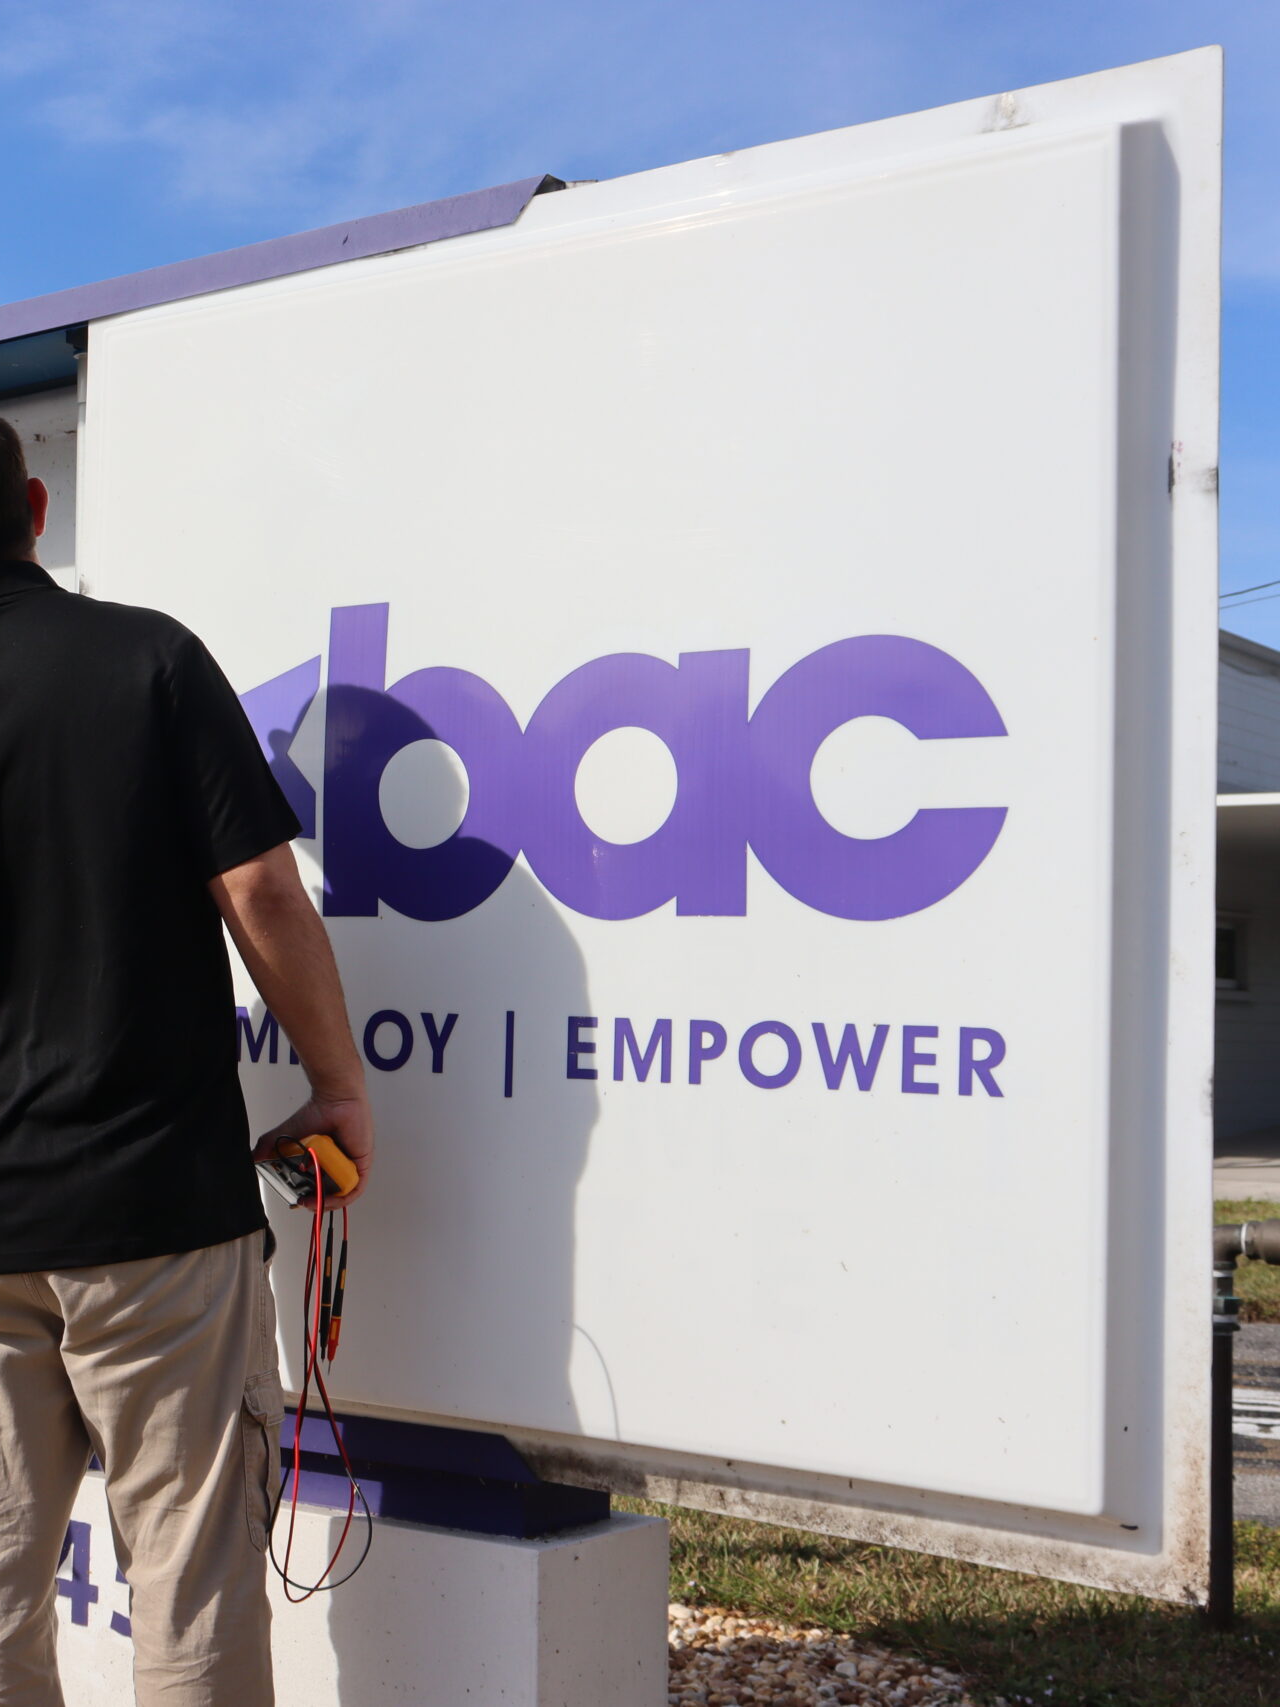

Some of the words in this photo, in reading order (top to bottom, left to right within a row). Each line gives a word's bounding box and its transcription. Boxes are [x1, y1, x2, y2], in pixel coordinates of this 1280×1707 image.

[322, 602, 1008, 922] bac
[234, 1005, 460, 1074] MOY
[566, 1015, 1007, 1099] EMPOWER
